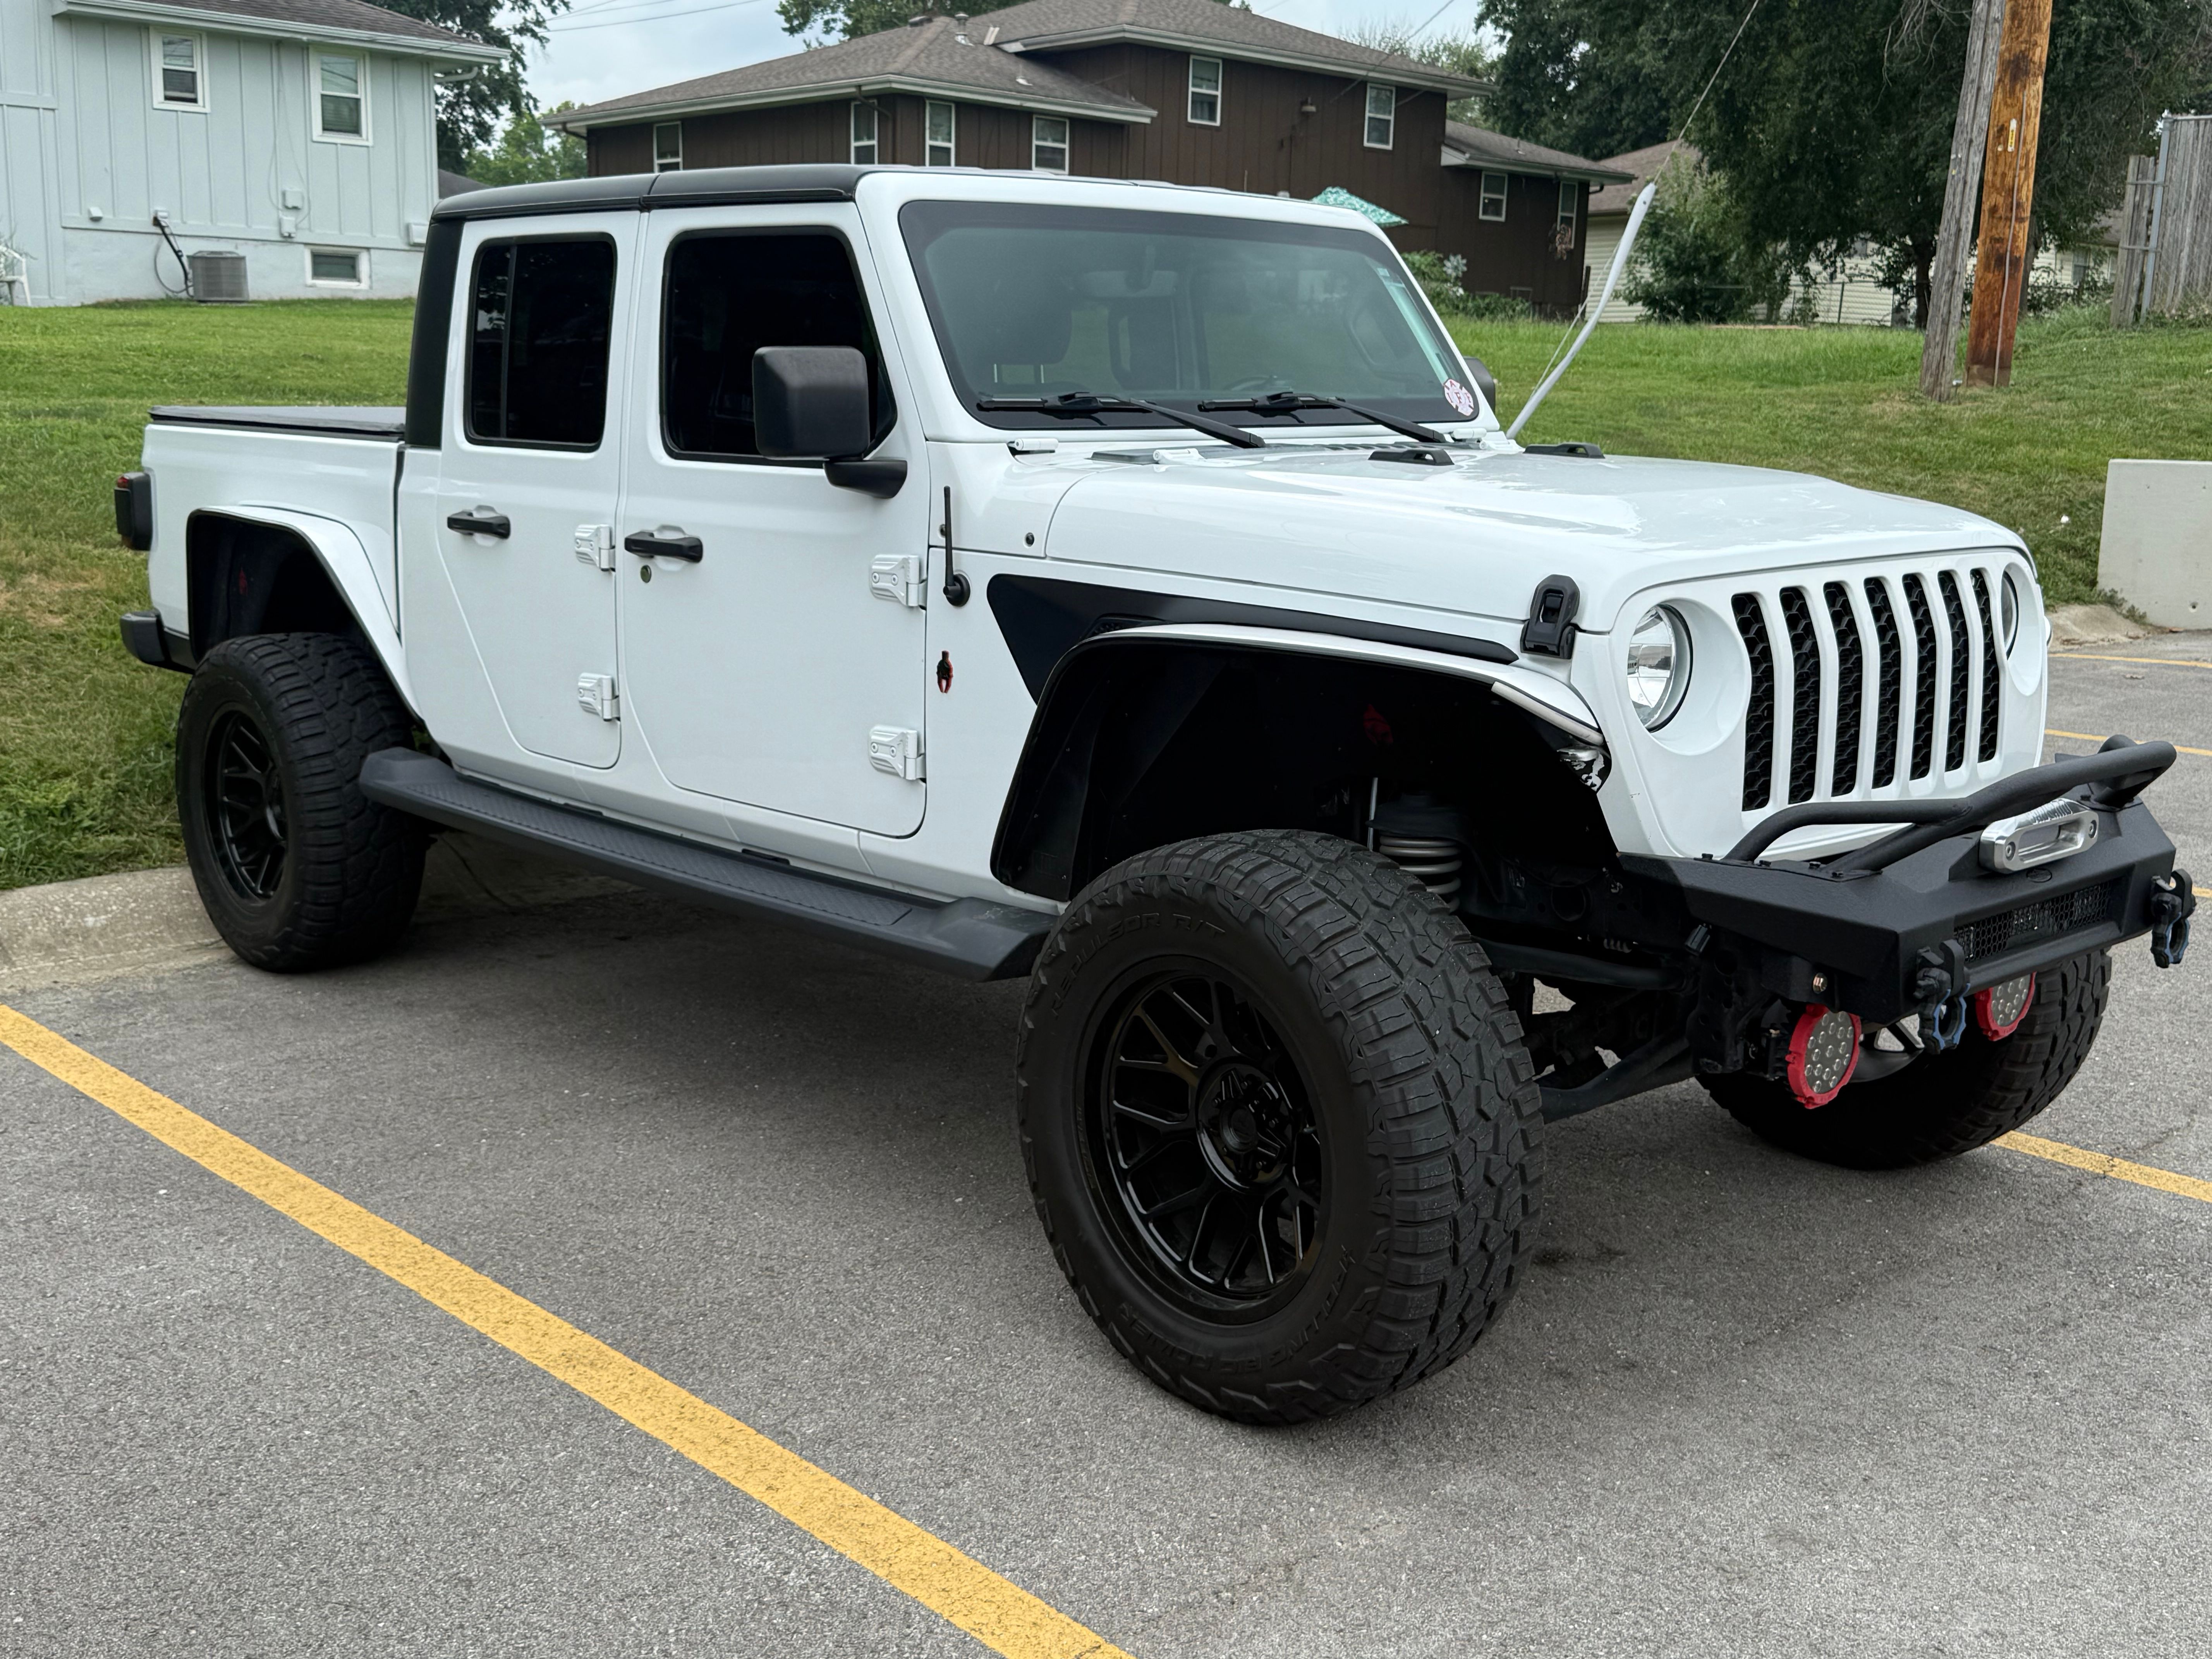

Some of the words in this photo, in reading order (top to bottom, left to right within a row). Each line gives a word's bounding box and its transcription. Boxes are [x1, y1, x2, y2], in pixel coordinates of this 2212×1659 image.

[1051, 912, 1161, 1020] REPULSOR
[1172, 913, 1226, 938] R/T
[1120, 1302, 1213, 1370] POWER
